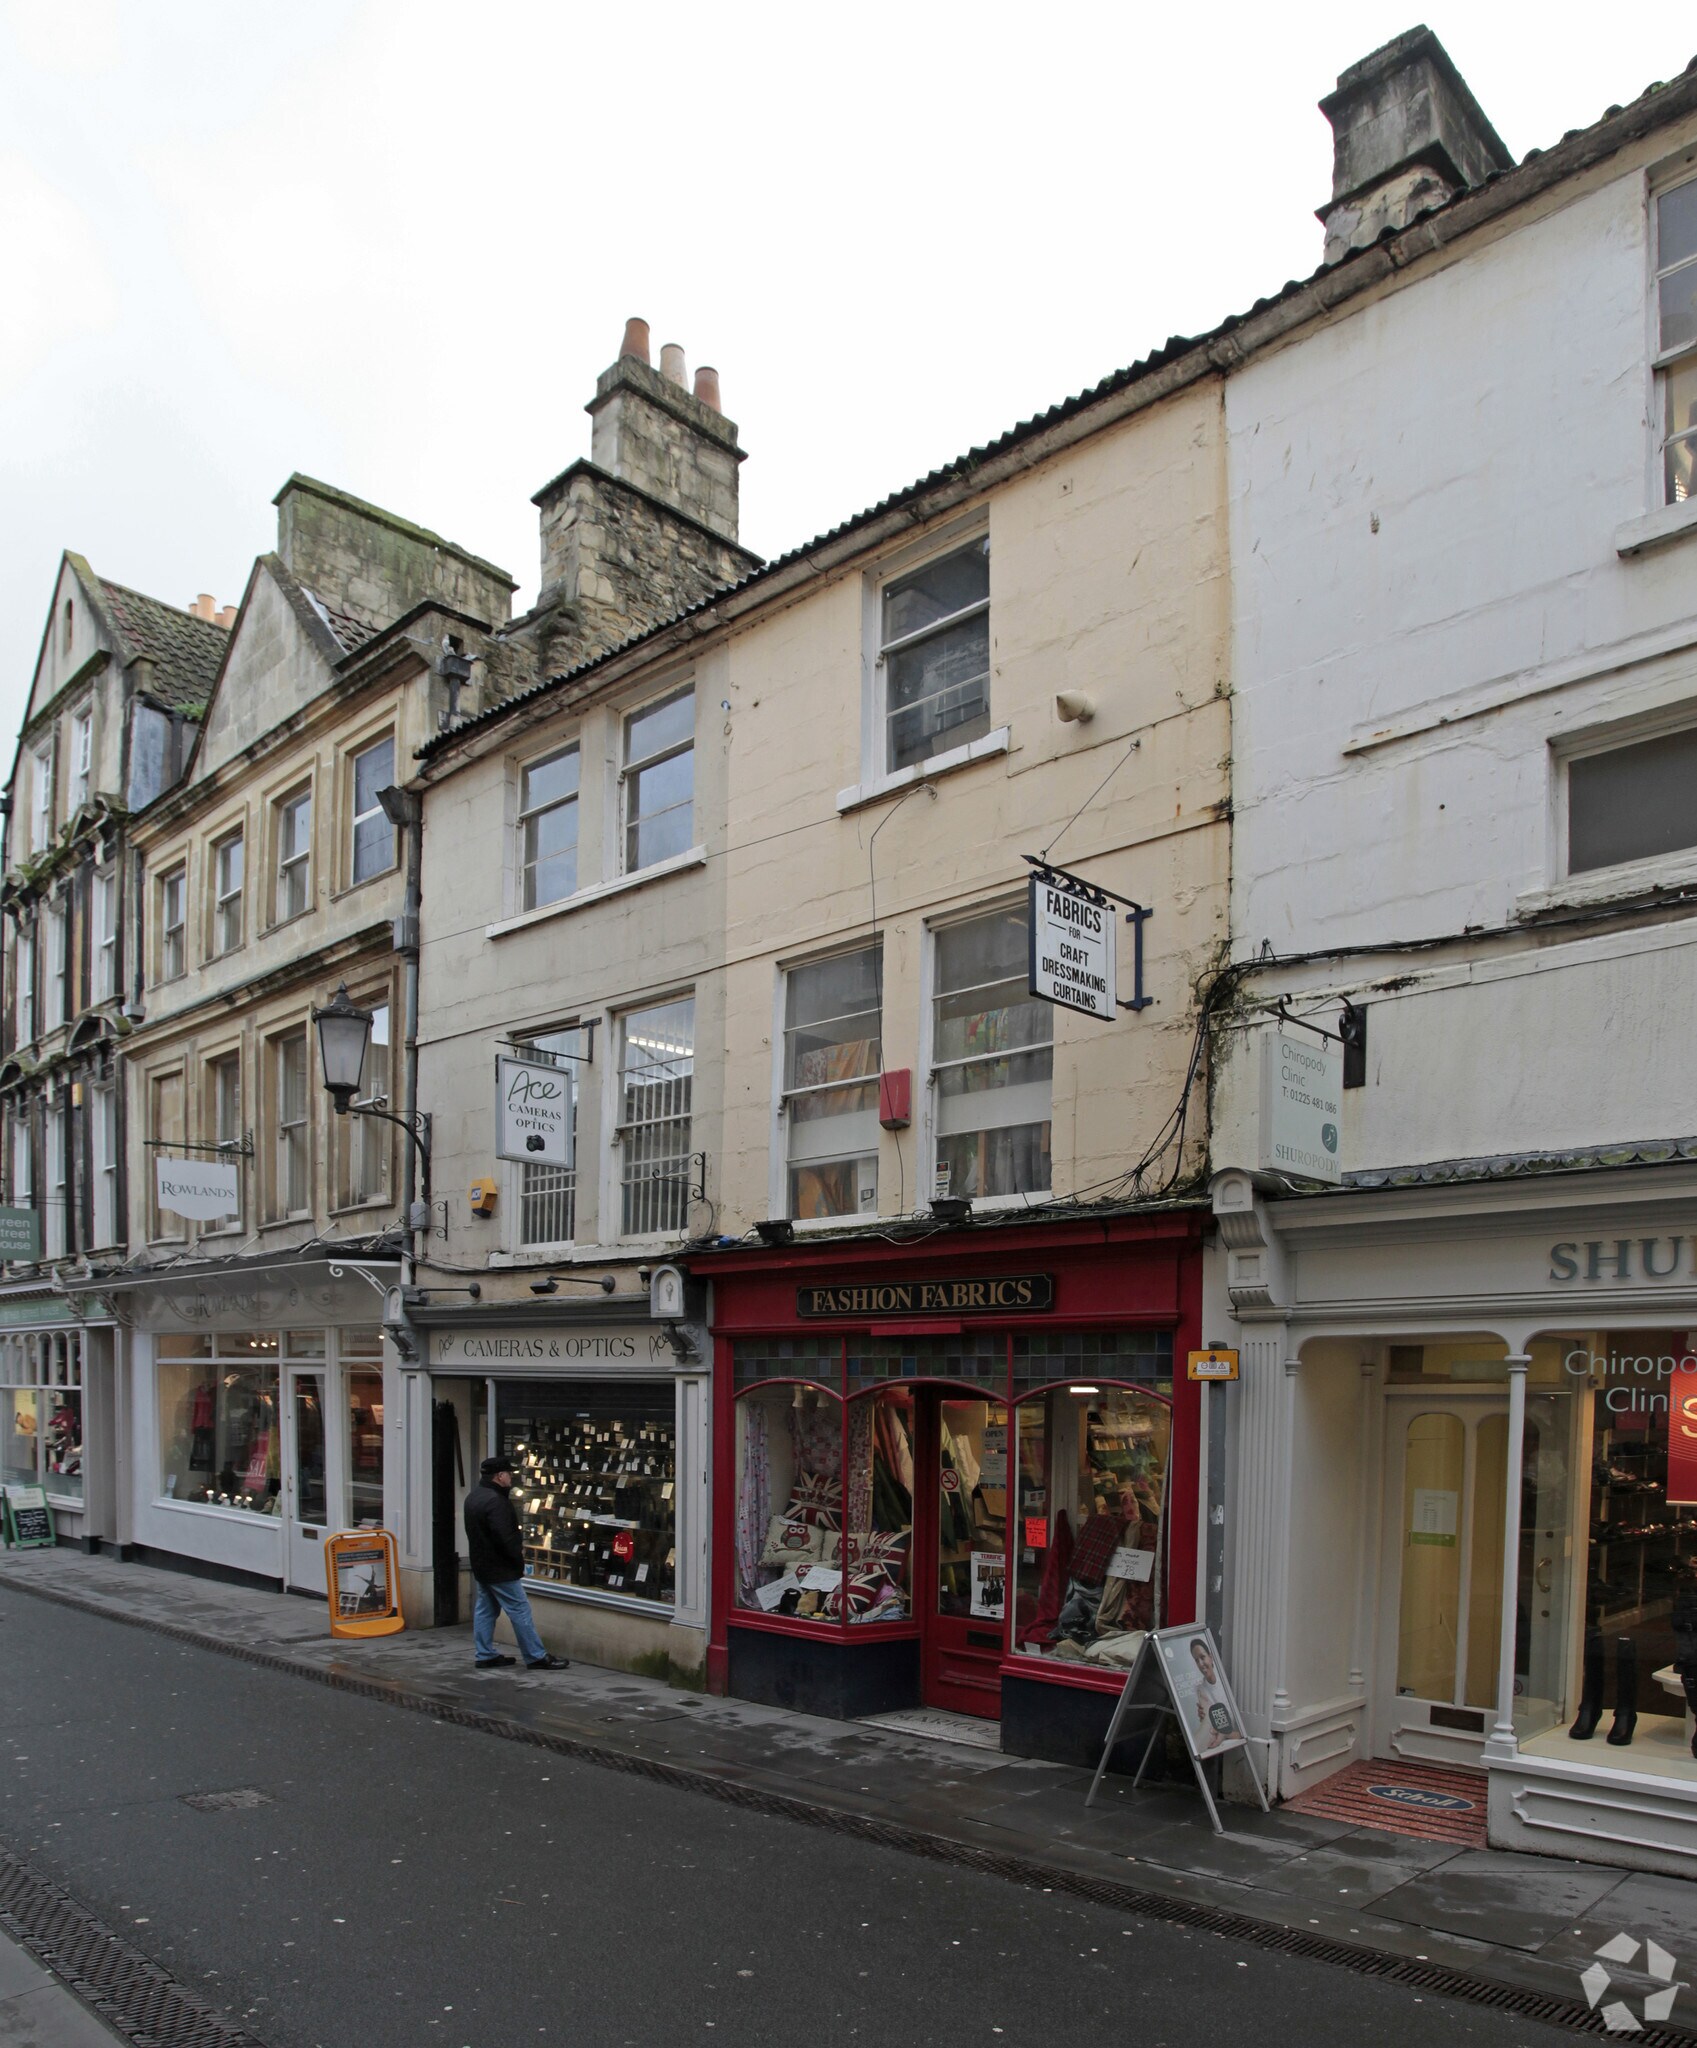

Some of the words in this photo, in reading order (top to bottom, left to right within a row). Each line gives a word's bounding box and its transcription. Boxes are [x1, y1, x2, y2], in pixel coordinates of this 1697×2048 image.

[1046, 889, 1102, 933] FABRICS
[1068, 926, 1081, 940] FOR
[1060, 942, 1089, 967] CRAFT
[1042, 956, 1106, 993] DRESSMAKING
[1053, 981, 1096, 1010] CURTAINS
[1281, 1043, 1327, 1077] Chiropody
[507, 1070, 562, 1103] Ace
[1281, 1065, 1306, 1087] Clinic
[508, 1102, 562, 1121] CAMERAS
[1282, 1085, 1289, 1098] T:
[1290, 1088, 1311, 1106] 01225
[1312, 1097, 1324, 1110] 481
[1325, 1102, 1337, 1115] 086
[516, 1118, 555, 1133] OPTICS
[1275, 1143, 1339, 1174] SHUROPODY
[0, 1218, 31, 1228] reen
[0, 1228, 31, 1240] treet
[0, 1240, 31, 1250] ouse
[811, 1286, 913, 1313] FASHION
[919, 1279, 1032, 1308] FABRICS
[438, 1334, 455, 1362] Ace
[464, 1338, 544, 1358] CAMERAS
[549, 1340, 560, 1357] &
[565, 1337, 635, 1357] OPTICS
[985, 1430, 1004, 1438] OPEN
[1383, 1789, 1459, 1806] Scholl
